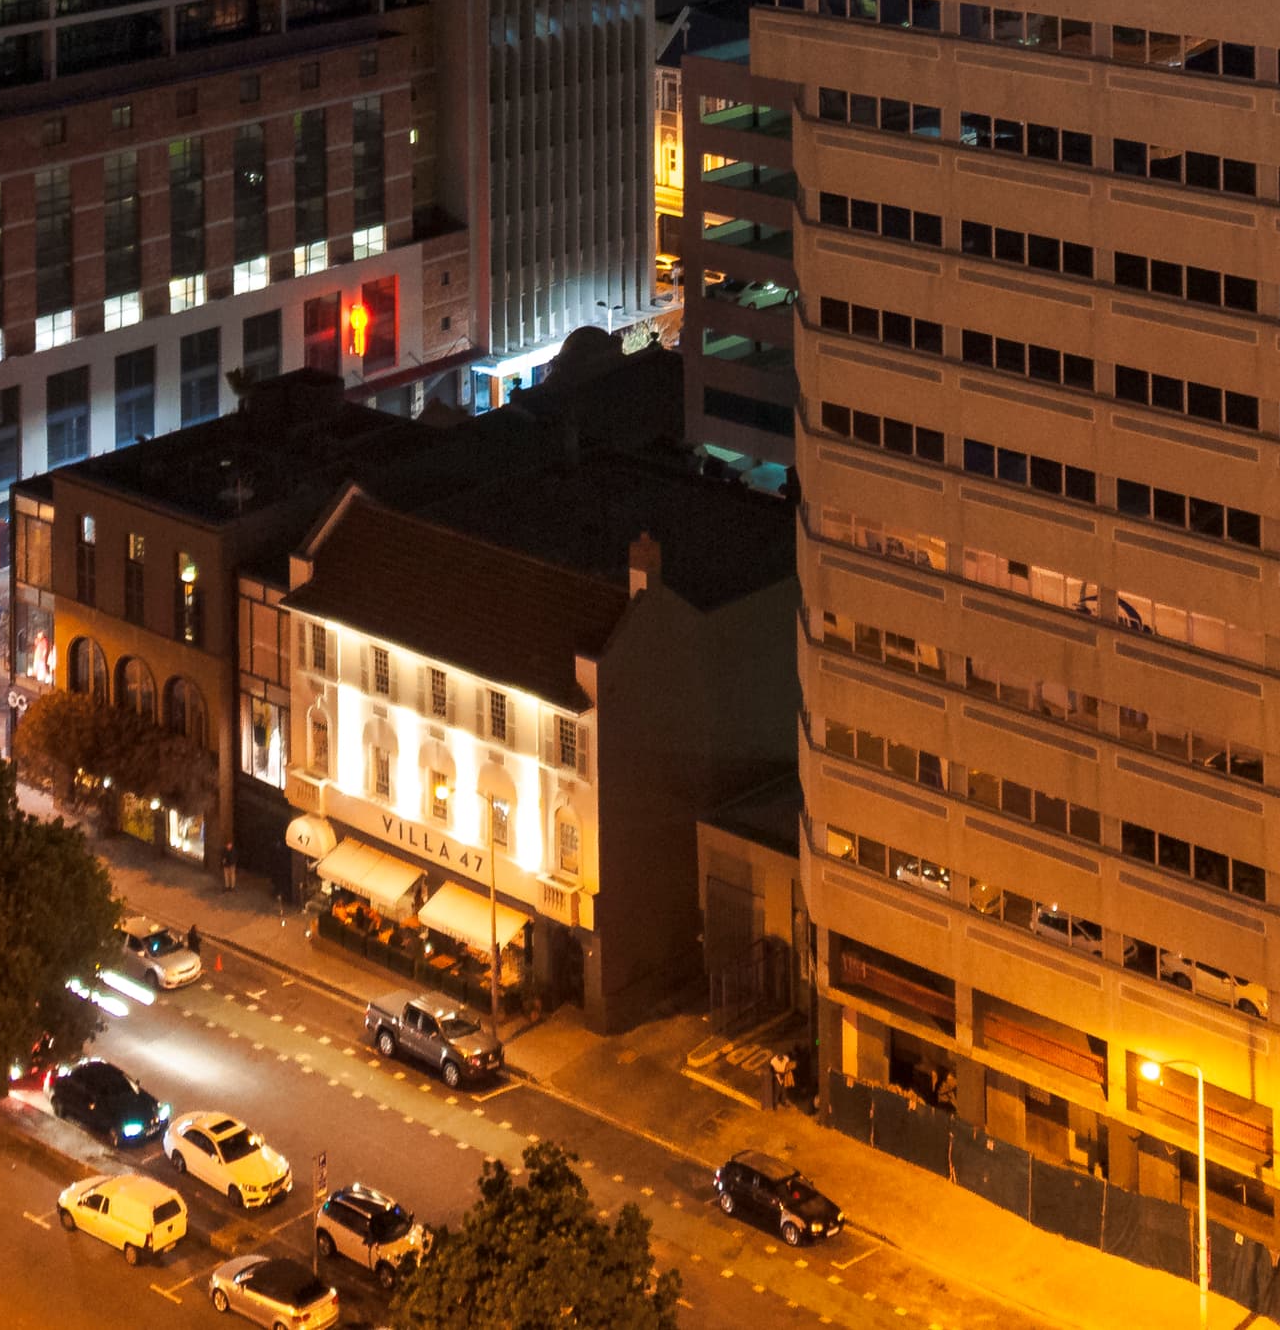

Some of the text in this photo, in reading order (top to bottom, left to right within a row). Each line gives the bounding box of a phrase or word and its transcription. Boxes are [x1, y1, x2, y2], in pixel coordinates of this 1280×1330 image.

[297, 834, 311, 847] 47
[382, 814, 484, 873] VILLA 47
